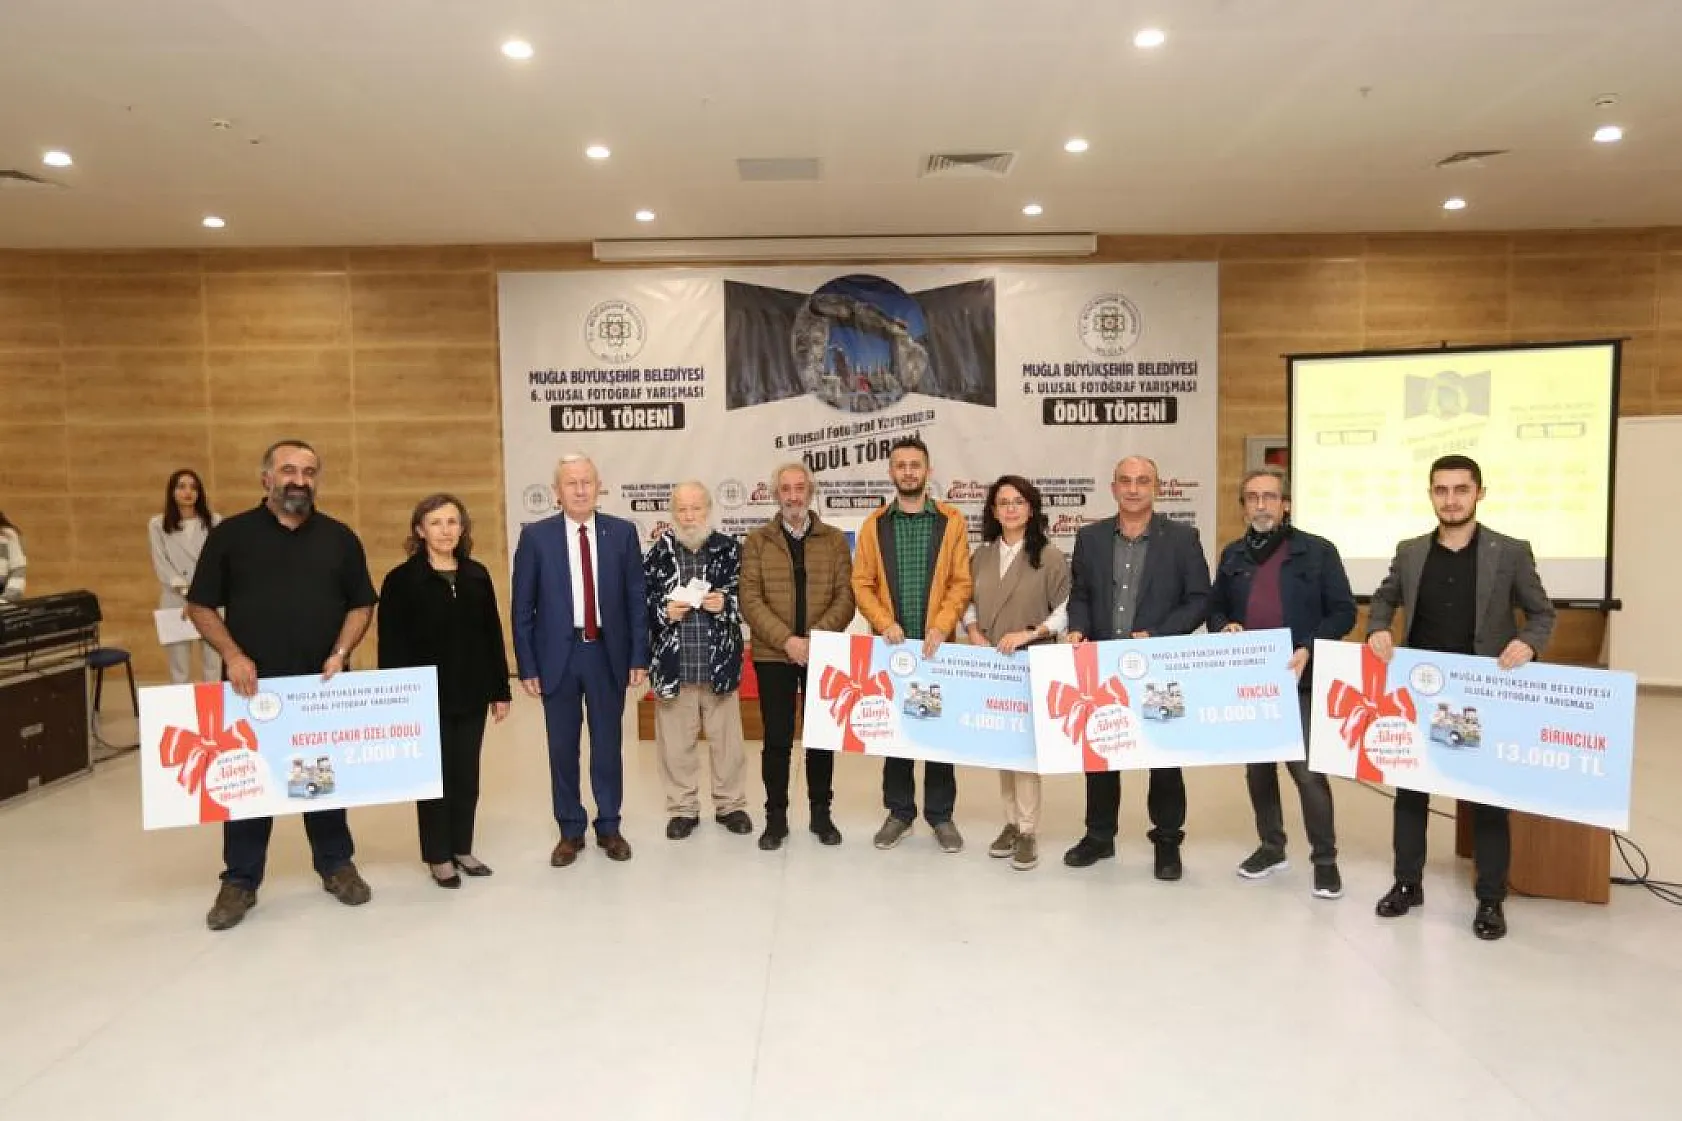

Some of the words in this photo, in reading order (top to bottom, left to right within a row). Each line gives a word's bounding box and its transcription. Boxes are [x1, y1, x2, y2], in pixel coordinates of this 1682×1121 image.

[529, 368, 567, 385] MUĞLA
[571, 366, 640, 385] BÜYÜKŞEHİR
[644, 365, 704, 382] BELEDİYESİ
[1022, 361, 1060, 377] MUĞLA
[1064, 360, 1134, 378] BÜYÜKŞEHİR
[1138, 359, 1198, 376] BELEDİYESİ
[530, 389, 541, 402] 6.
[545, 388, 584, 402] ULUSAL
[588, 386, 642, 400] FOTOĞRAF
[647, 384, 704, 401] YARIŞMASI
[1038, 381, 1077, 393] ULUSAL
[1081, 379, 1136, 393] FOTOĞRAF
[1140, 379, 1198, 395] YARIŞMASI
[561, 406, 607, 430] ÖDÜL
[611, 404, 675, 429] TÖRENİ
[1054, 399, 1100, 423] ÖDÜL
[1104, 398, 1167, 423] TÖRENİ
[788, 428, 825, 447] Ulusal
[985, 697, 1029, 713] MANSİYON
[1197, 705, 1257, 724] 10.000
[1260, 703, 1282, 720] TL
[1010, 716, 1028, 733] TL
[292, 731, 328, 747] NEVZAT
[331, 729, 361, 745] ÇAKIR
[364, 725, 387, 741] ÖZEL
[1540, 727, 1608, 750] BİRİNCİLİK
[345, 744, 396, 764] 2.000
[402, 741, 423, 759] TL
[1496, 742, 1570, 772] 13.000
[1578, 755, 1606, 777] TL
